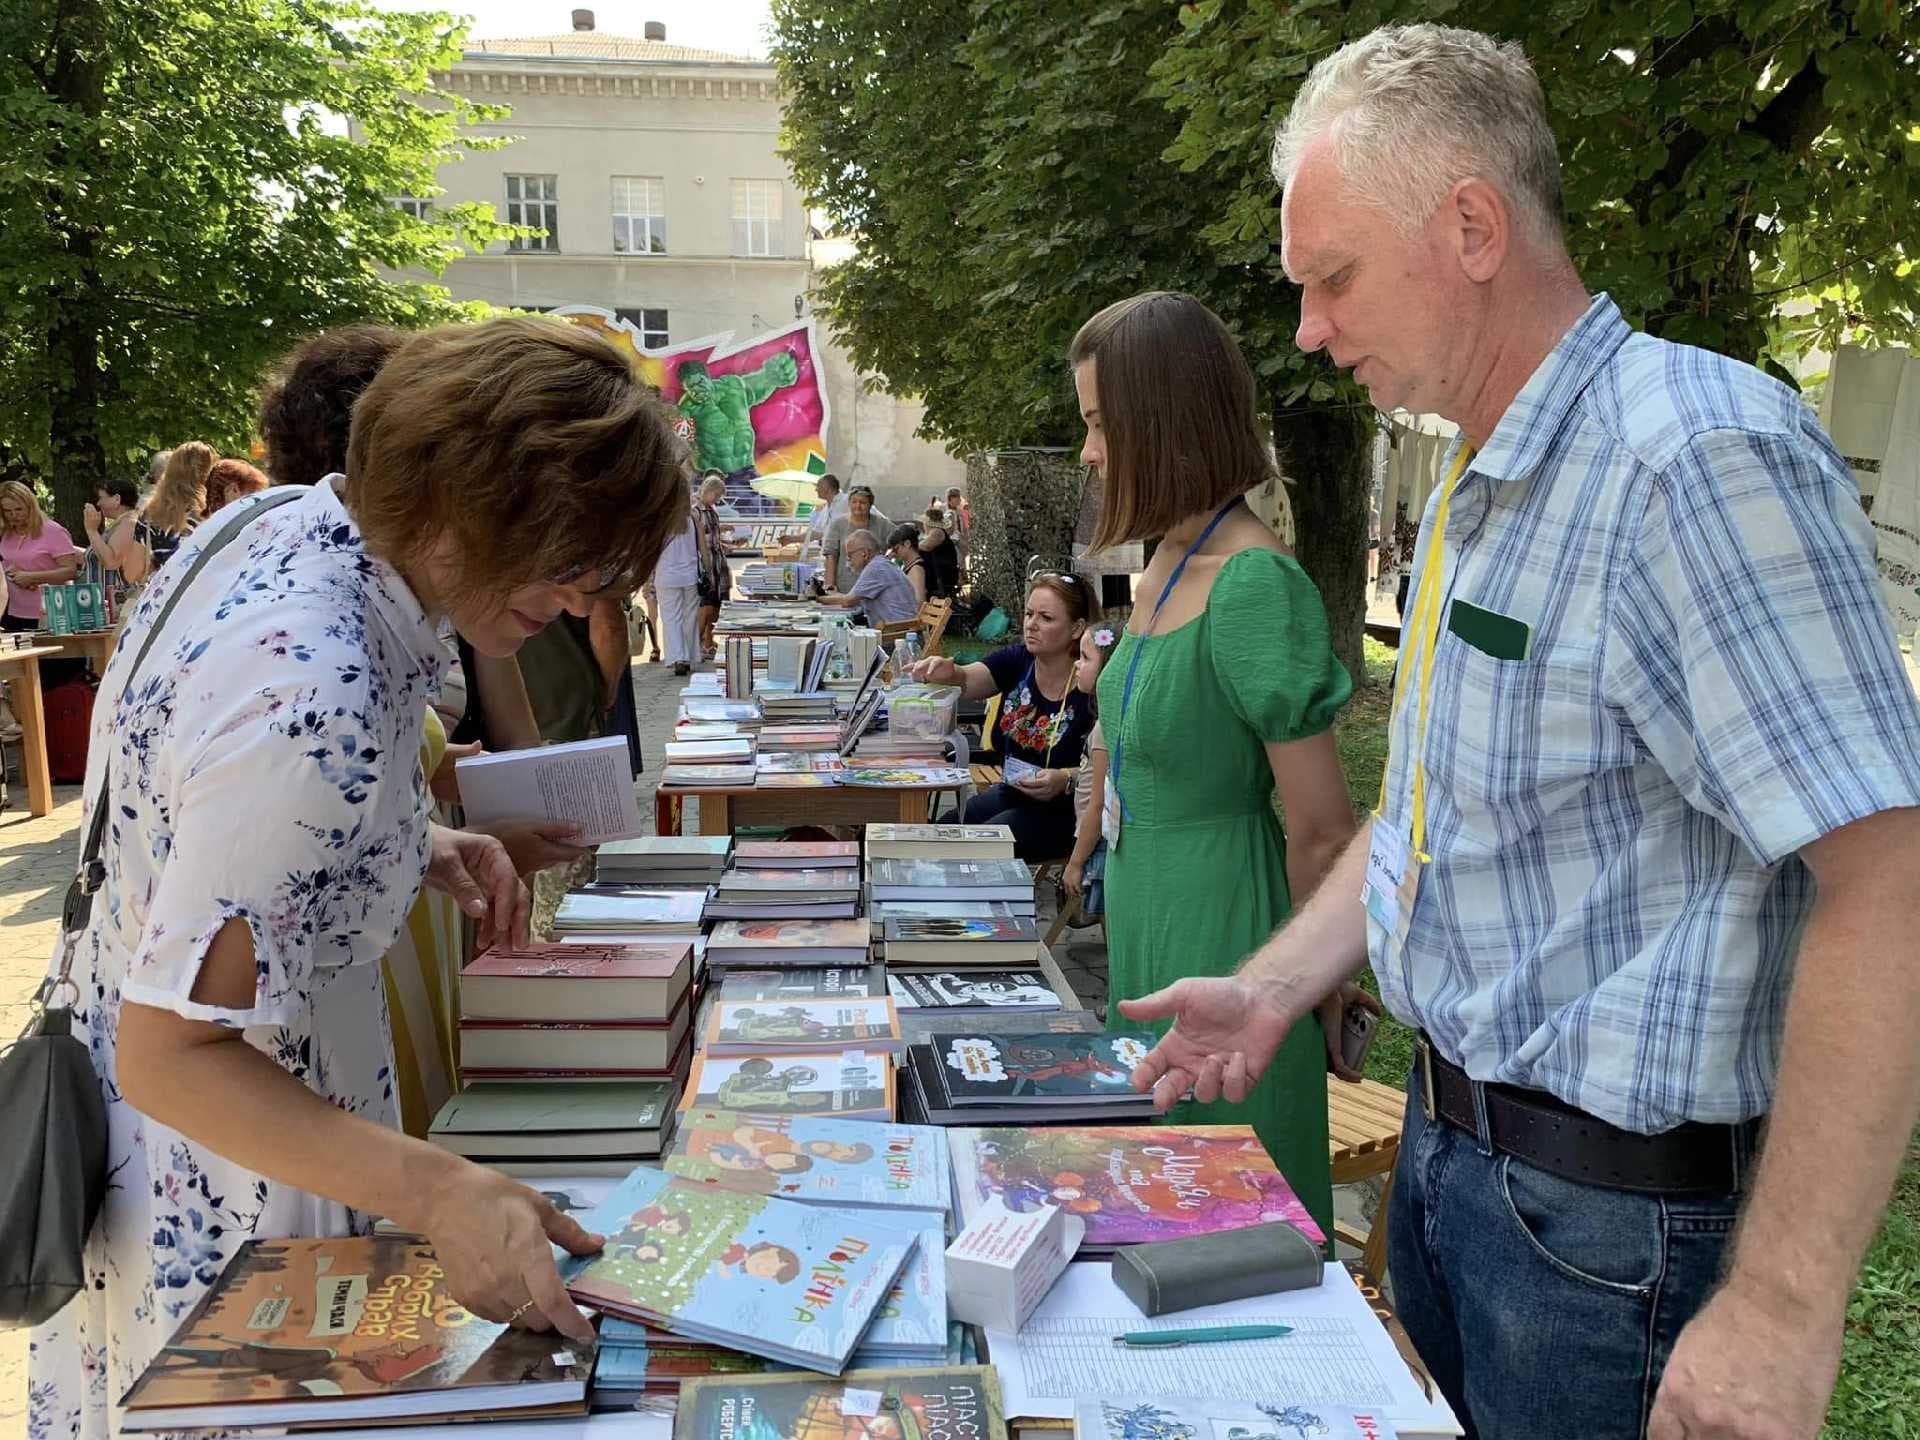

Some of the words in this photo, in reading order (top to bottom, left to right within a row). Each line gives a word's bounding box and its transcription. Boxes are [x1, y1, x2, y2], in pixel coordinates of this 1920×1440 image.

[883, 1136, 914, 1190] ПОЛІНКА
[332, 1280, 352, 1305] ТЕМНІ
[791, 1236, 870, 1323] ПОЛІНКА
[329, 1305, 347, 1329] ЧАСИ
